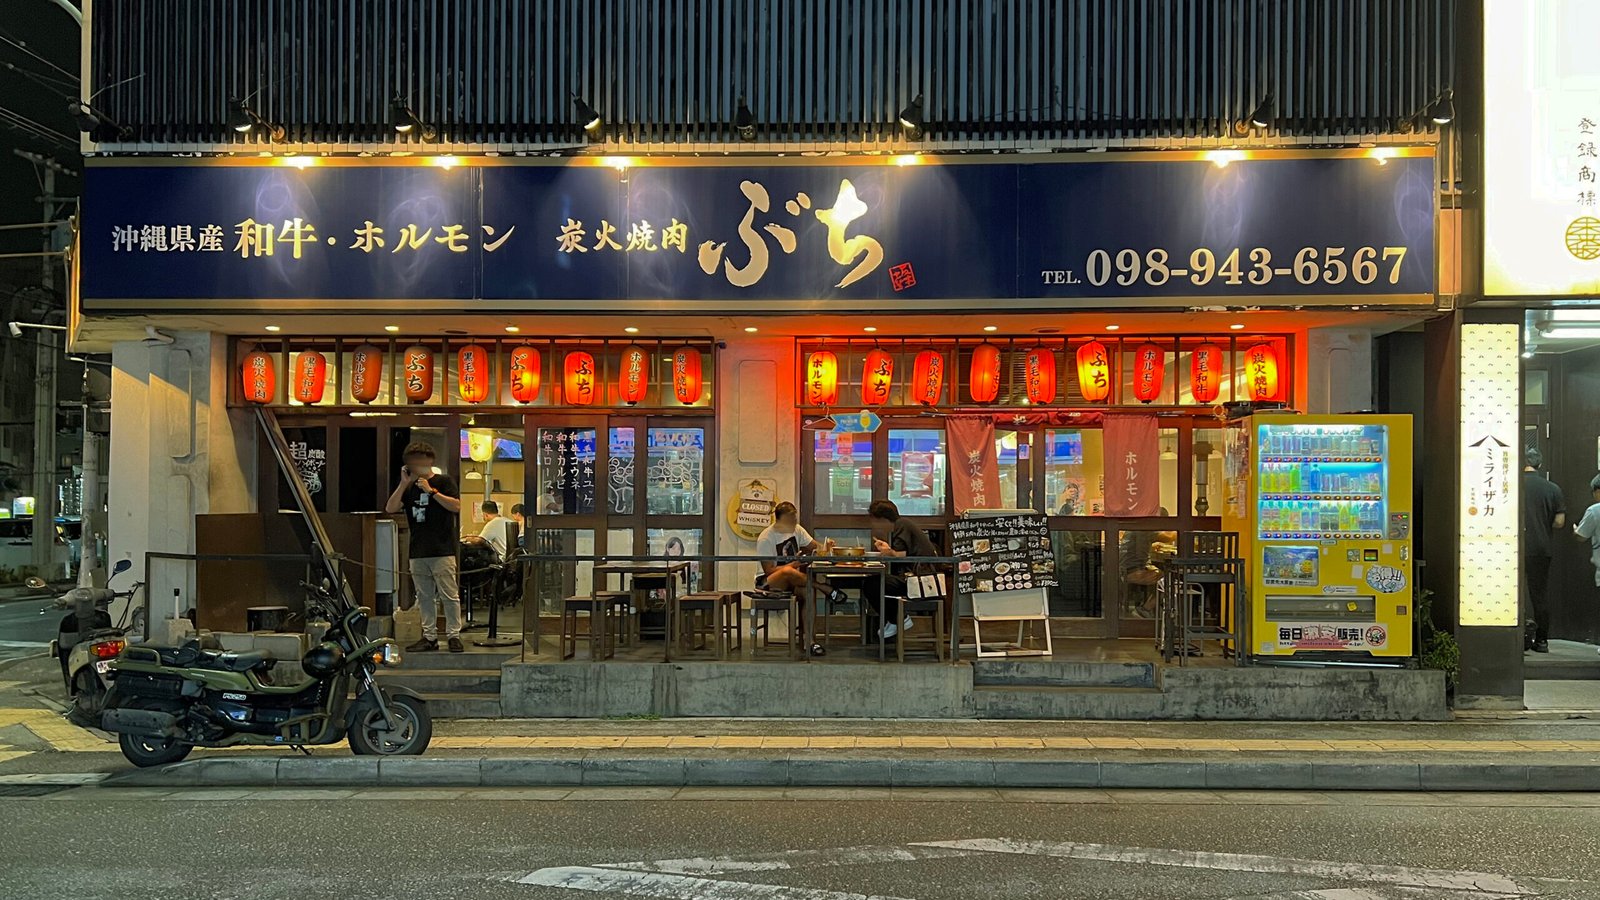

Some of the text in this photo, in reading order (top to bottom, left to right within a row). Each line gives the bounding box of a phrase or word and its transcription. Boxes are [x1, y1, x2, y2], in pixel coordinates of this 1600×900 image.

[1577, 117, 1598, 207] 登録商標
[111, 224, 224, 254] 沖縄県産
[554, 218, 688, 254] 炭火焼肉
[697, 178, 884, 289] ぶち
[1041, 246, 1409, 287] TEL. 098-943-6567
[252, 357, 267, 399] 炭火焼肉
[300, 356, 317, 399] 黒毛和牛
[353, 351, 368, 396] ホルモン
[406, 353, 427, 393] ぶち
[463, 351, 476, 396] 黒毛和牛
[511, 353, 528, 392] ぶち
[575, 359, 594, 396] ぶち
[628, 352, 643, 395] ホルモン
[811, 358, 823, 399] ホルモン
[874, 359, 893, 397] ぶち
[926, 356, 942, 399] 炭火焼肉
[1029, 354, 1041, 398] 黒毛和牛
[1141, 351, 1157, 394] ホルモン
[1195, 351, 1209, 395] 黒毛和牛
[1252, 352, 1267, 397] 炭火焼肉
[555, 431, 568, 491] 和牛カルビ
[967, 449, 986, 507] 炭火焼肉
[1124, 451, 1140, 512] ホルモン
[1483, 448, 1497, 517] ミライザカ
[738, 515, 771, 525] WHISKEY
[741, 501, 771, 513] CLOSED
